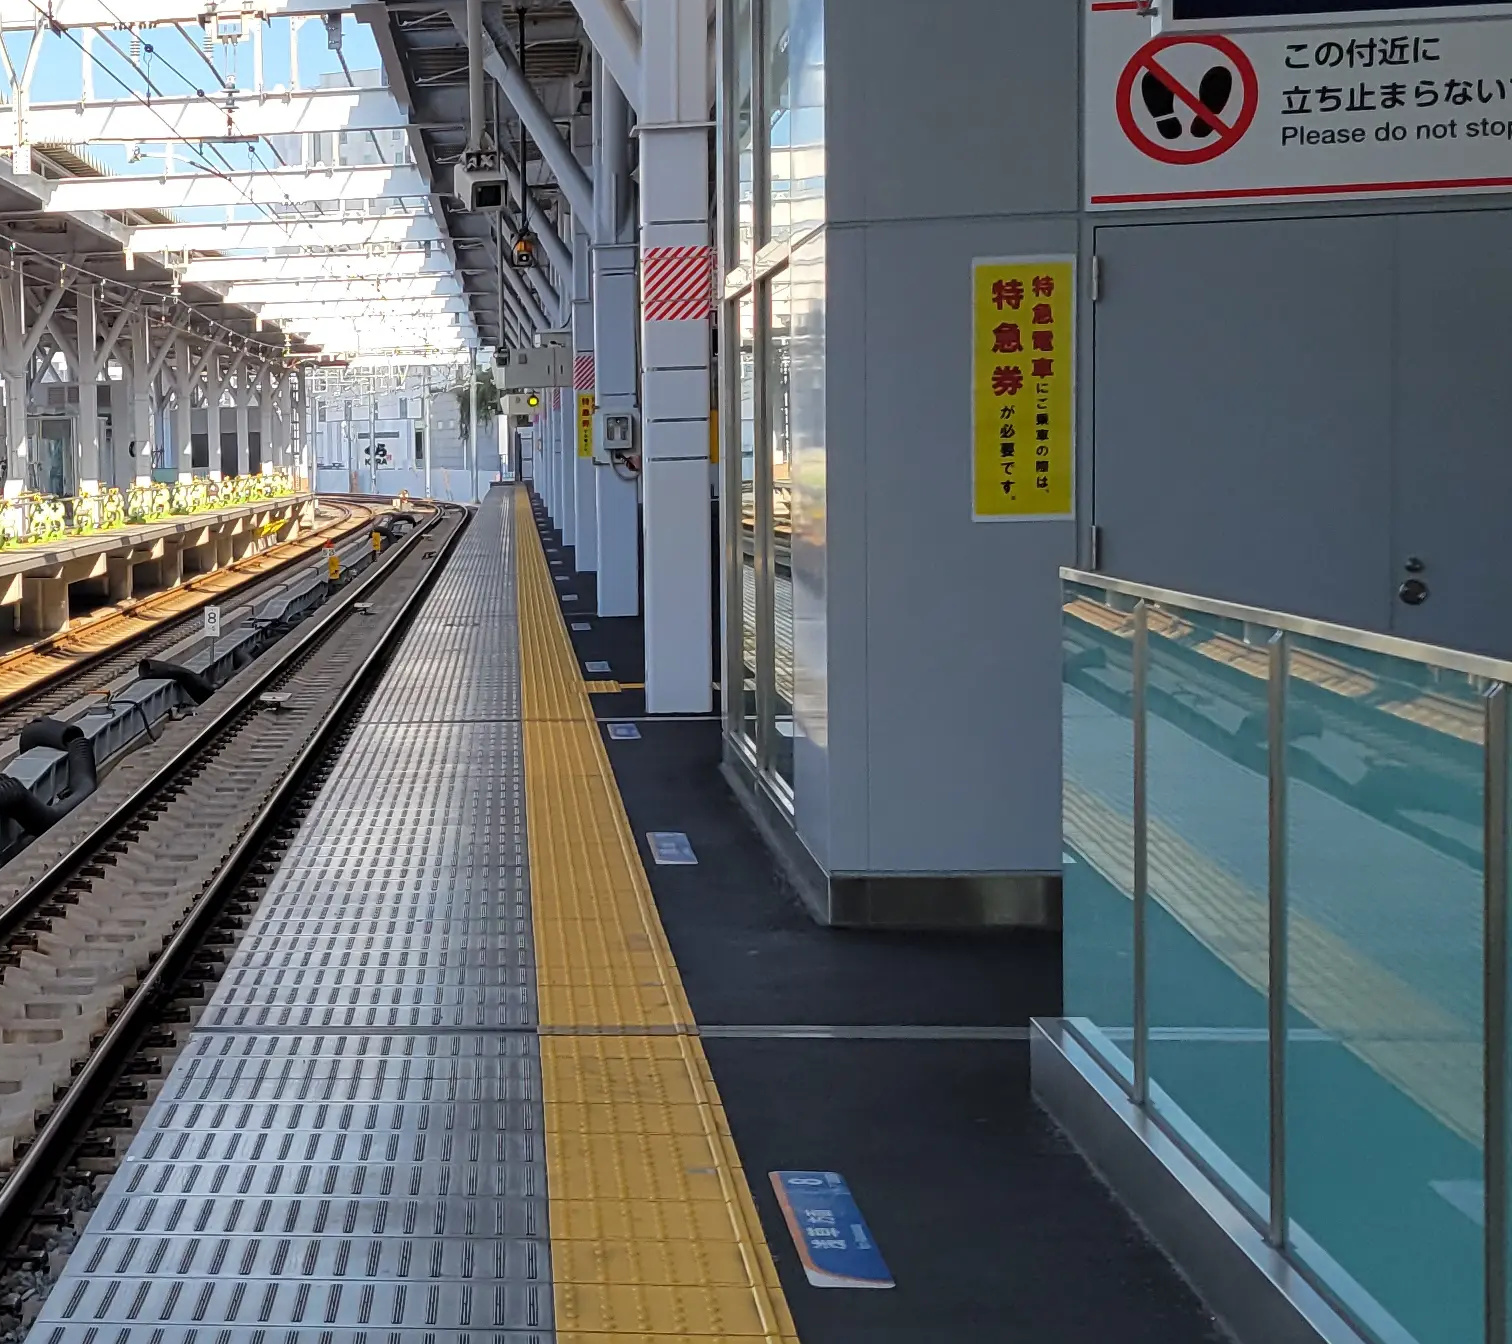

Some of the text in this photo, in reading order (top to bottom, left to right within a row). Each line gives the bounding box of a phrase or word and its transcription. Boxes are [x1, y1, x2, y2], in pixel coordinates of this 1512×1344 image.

[1285, 36, 1440, 68] この付近に
[1281, 78, 1512, 114] 立ち止まらない
[1281, 125, 1366, 146] Please
[1374, 122, 1407, 142] do
[1416, 119, 1457, 139] not
[364, 458, 387, 466] KRA
[208, 612, 216, 624] 8
